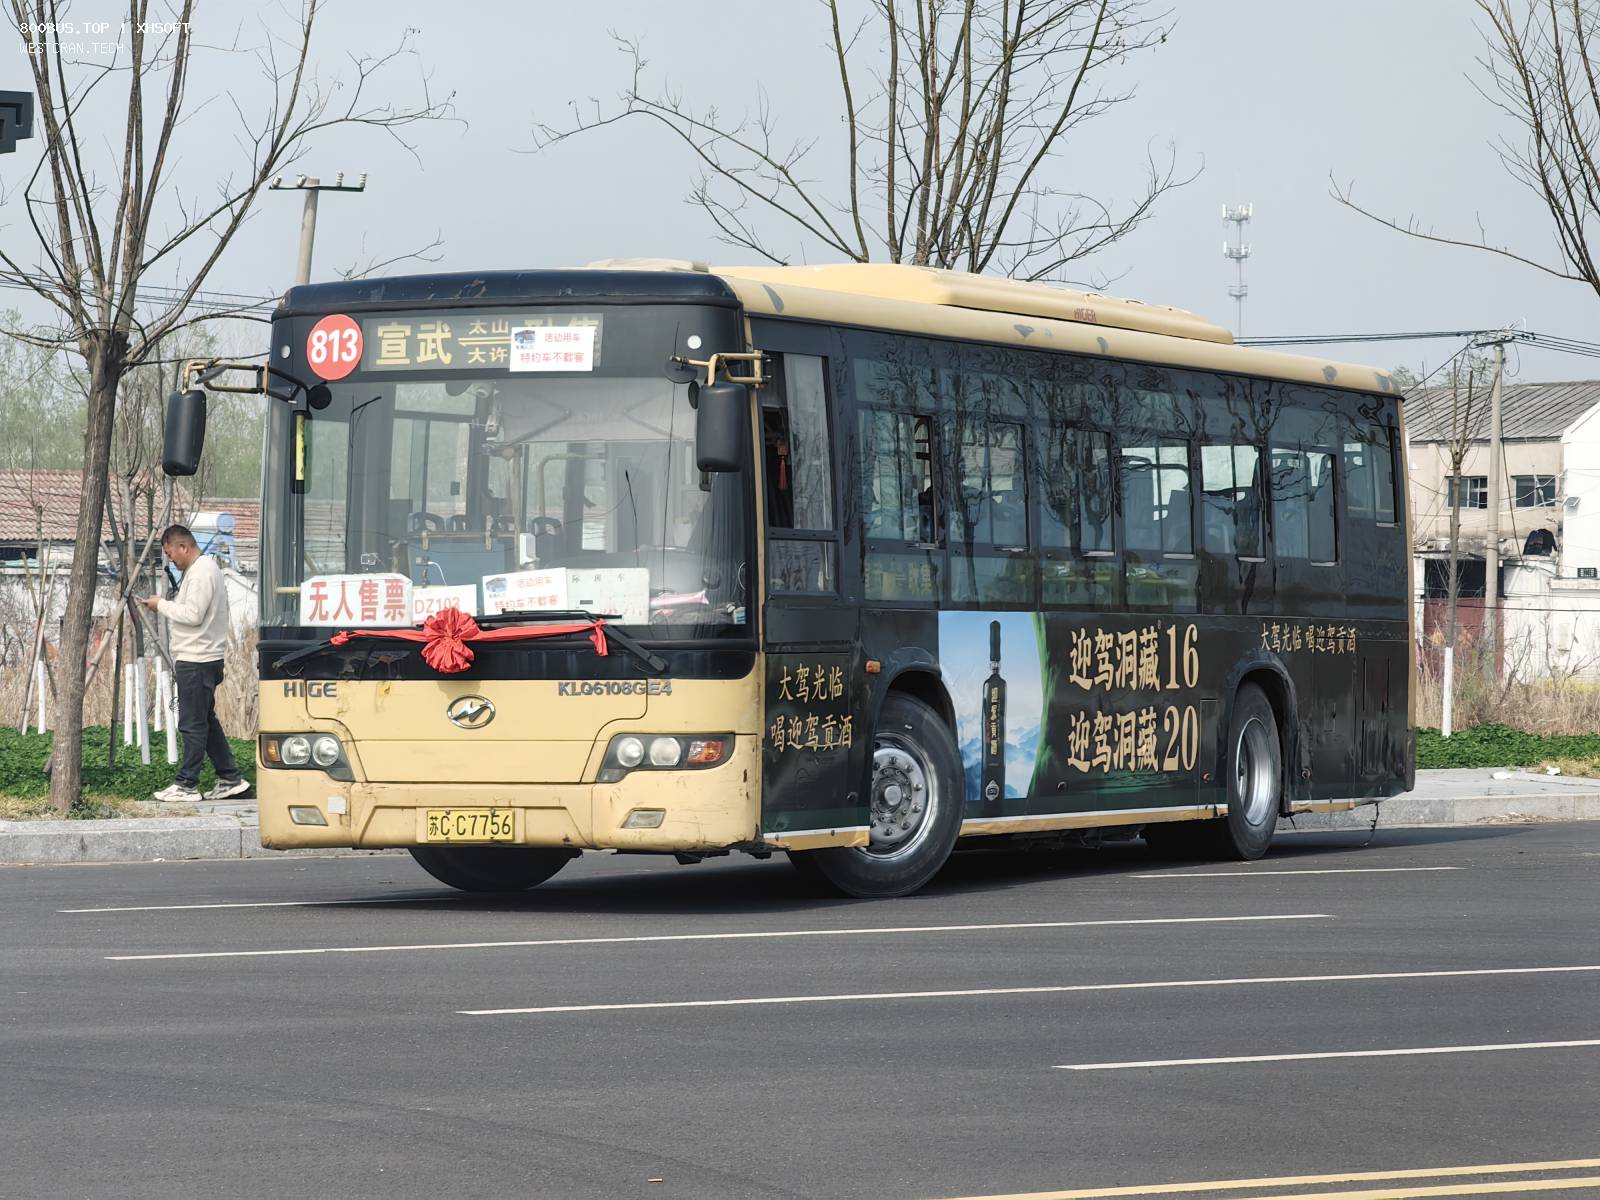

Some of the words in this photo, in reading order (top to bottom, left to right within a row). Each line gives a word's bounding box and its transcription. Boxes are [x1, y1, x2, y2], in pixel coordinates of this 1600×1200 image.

[376, 321, 453, 366] 宣武
[468, 320, 509, 335] 太山
[310, 329, 358, 363] 813
[468, 347, 509, 364] 大许
[309, 578, 407, 622] 无人售票
[1260, 621, 1303, 653] 大驾光临
[1305, 623, 1357, 655] 喝迎驾贡酒
[283, 681, 337, 698] HIGE
[558, 680, 673, 697] KLQ6108GE4
[778, 663, 845, 704] 大驾光临
[770, 712, 854, 753] 喝迎驾贡酒
